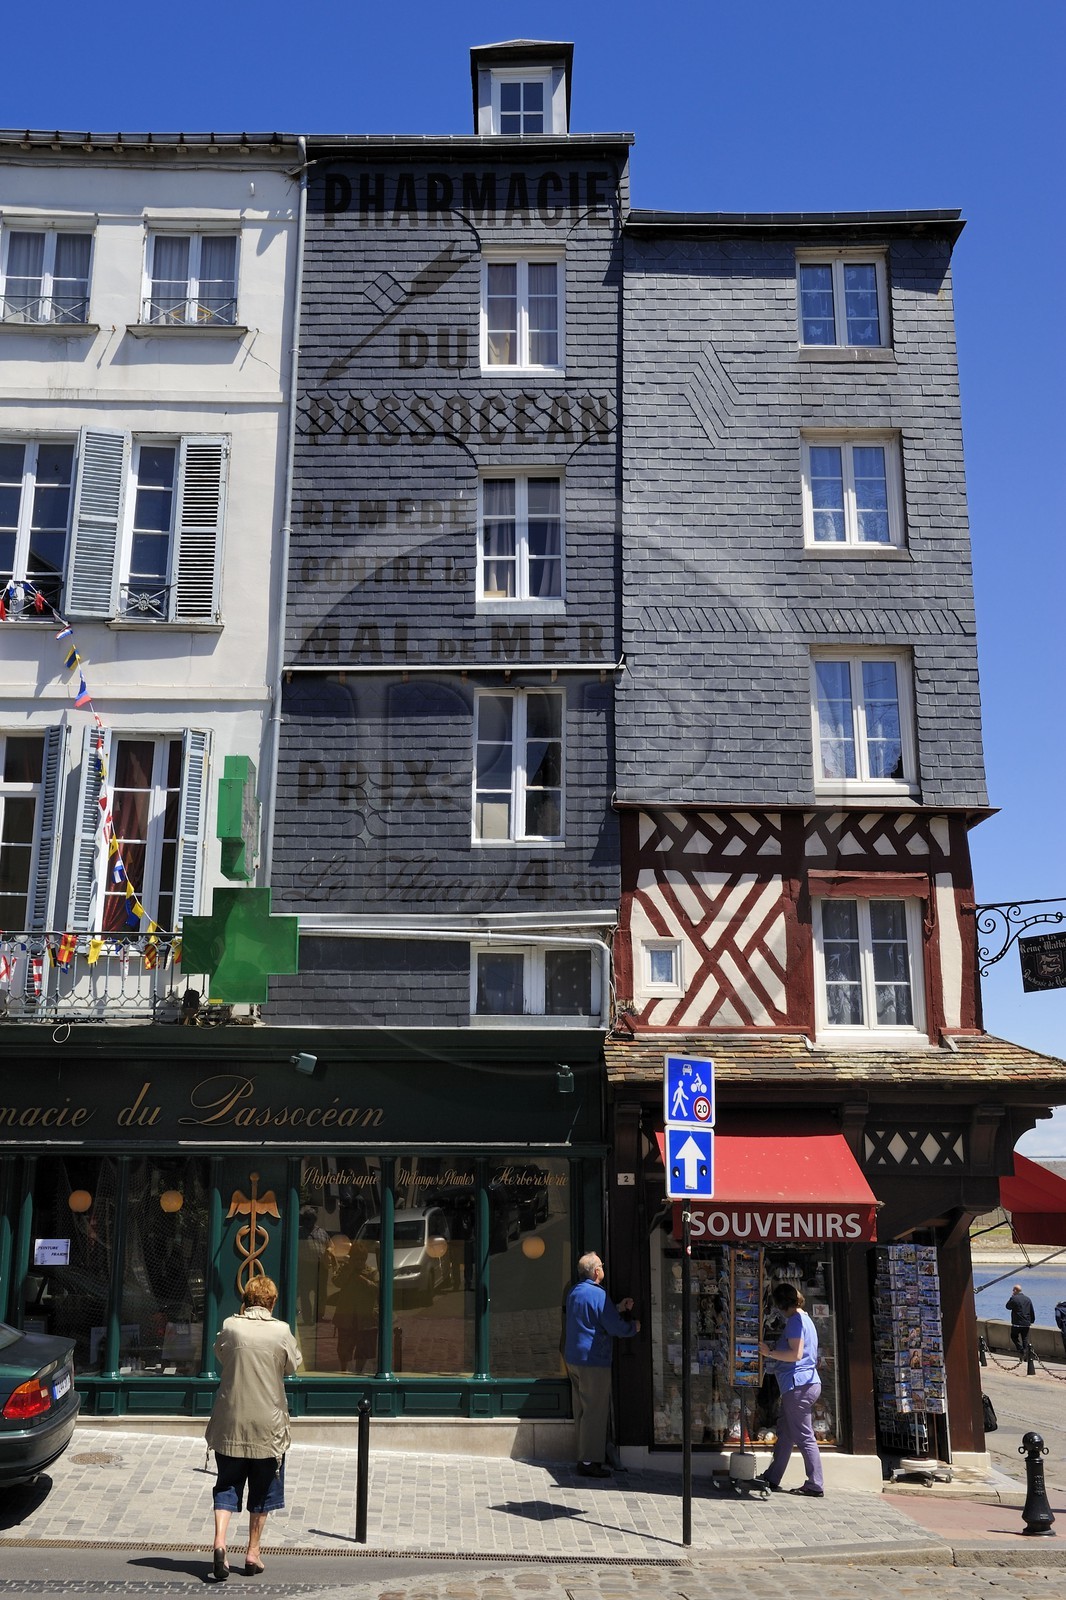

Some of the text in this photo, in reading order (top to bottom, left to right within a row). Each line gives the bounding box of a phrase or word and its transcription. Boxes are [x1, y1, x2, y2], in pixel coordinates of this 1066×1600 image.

[323, 171, 611, 228] PHARMACIE
[399, 328, 468, 370] DU
[301, 555, 469, 586] CONTRE le
[300, 621, 605, 660] MAL DE MER
[282, 853, 348, 903] Le
[516, 858, 553, 902] 4
[1020, 944, 1042, 954] Reine
[117, 1082, 162, 1127] du
[177, 1074, 385, 1128] Passocéan
[697, 1104, 708, 1114] 20
[492, 1165, 569, 1186] Herboristerie
[623, 1175, 629, 1183] 2
[690, 1211, 862, 1238] SOUVENIRS
